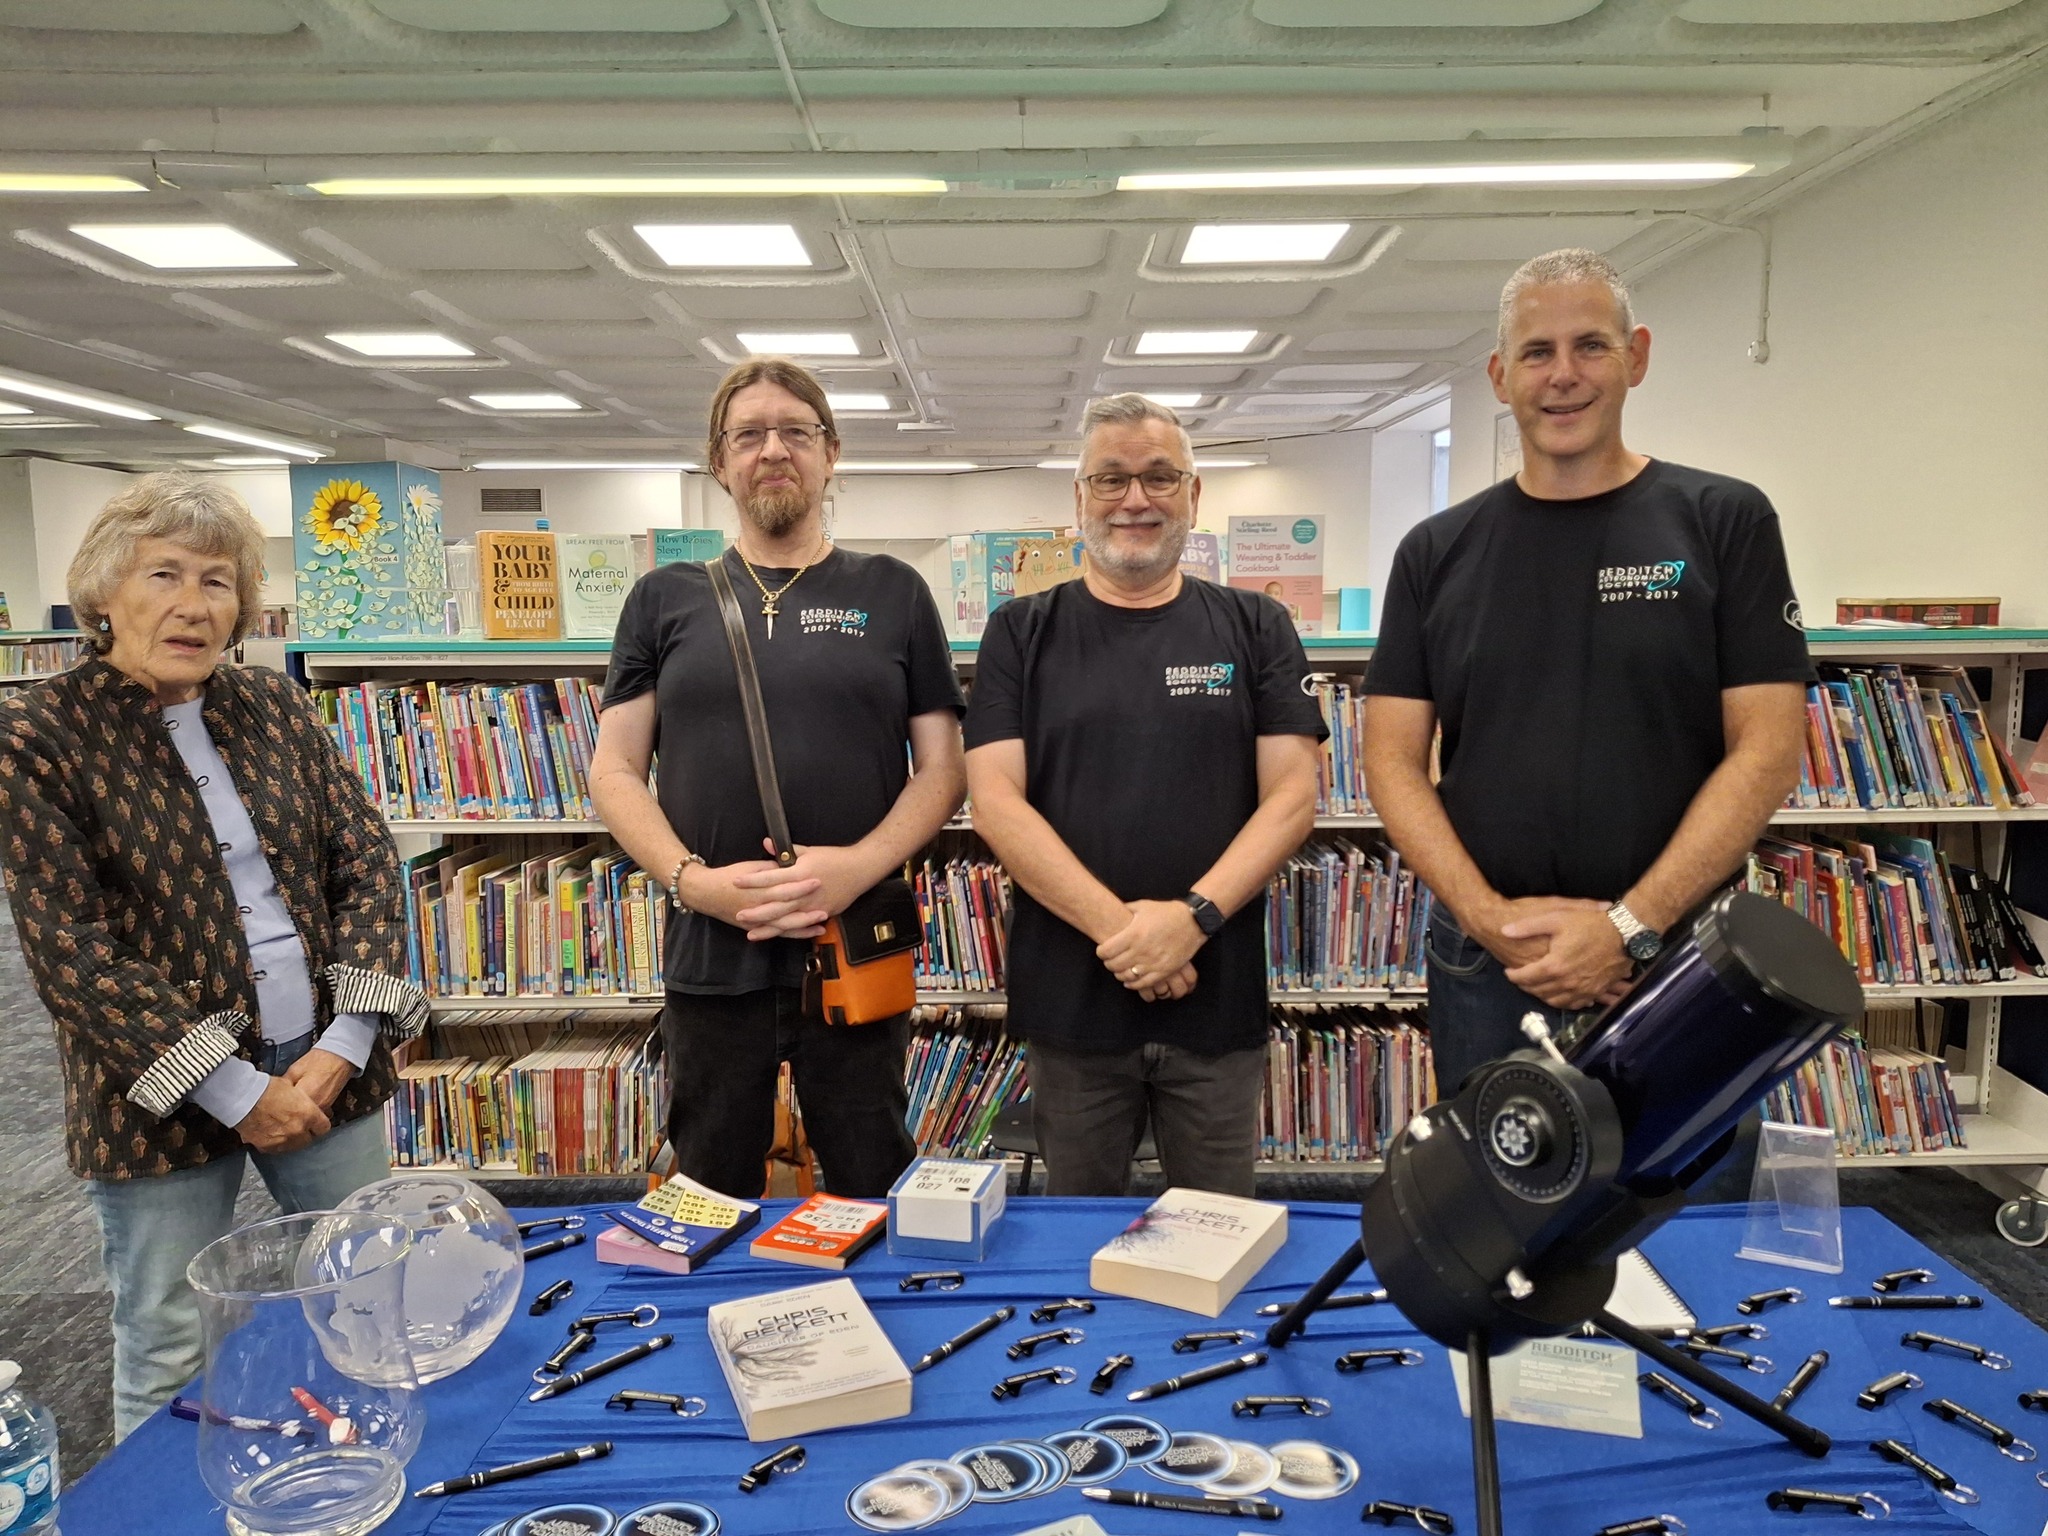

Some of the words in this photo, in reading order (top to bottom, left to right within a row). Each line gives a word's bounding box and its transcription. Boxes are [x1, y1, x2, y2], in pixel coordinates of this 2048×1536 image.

[656, 534, 680, 544] How
[492, 544, 551, 561] YOUR
[656, 546, 682, 556] Sleep
[1236, 542, 1252, 551] The
[1254, 542, 1292, 551] Ultimate
[1236, 554, 1274, 563] Weaning
[1275, 553, 1282, 561] &
[1284, 552, 1316, 561] Toddler
[493, 562, 552, 578] BABY
[568, 566, 628, 579] Maternal
[1236, 564, 1280, 572] Cookbook
[1599, 566, 1673, 578] REDDITCH
[493, 578, 510, 595] &
[574, 582, 624, 596] Anxiety
[494, 595, 555, 609] CHILD
[1601, 591, 1632, 603] 2007
[1645, 590, 1679, 600] 2017
[495, 610, 555, 620] PENELOPE
[506, 619, 546, 628] LEACH
[803, 624, 830, 634] 2007
[840, 626, 865, 637] 2017
[1170, 686, 1197, 696] 2007
[1206, 688, 1232, 696] 2017
[1180, 1208, 1240, 1223] CHRIS
[758, 1306, 828, 1327] CHRIS
[743, 1312, 848, 1340] BECKETT
[747, 1336, 806, 1350] DAUGHTER
[829, 1324, 860, 1334] EDEN
[1532, 1342, 1612, 1362] REDDITCH
[1101, 1428, 1148, 1438] EDDITCH
